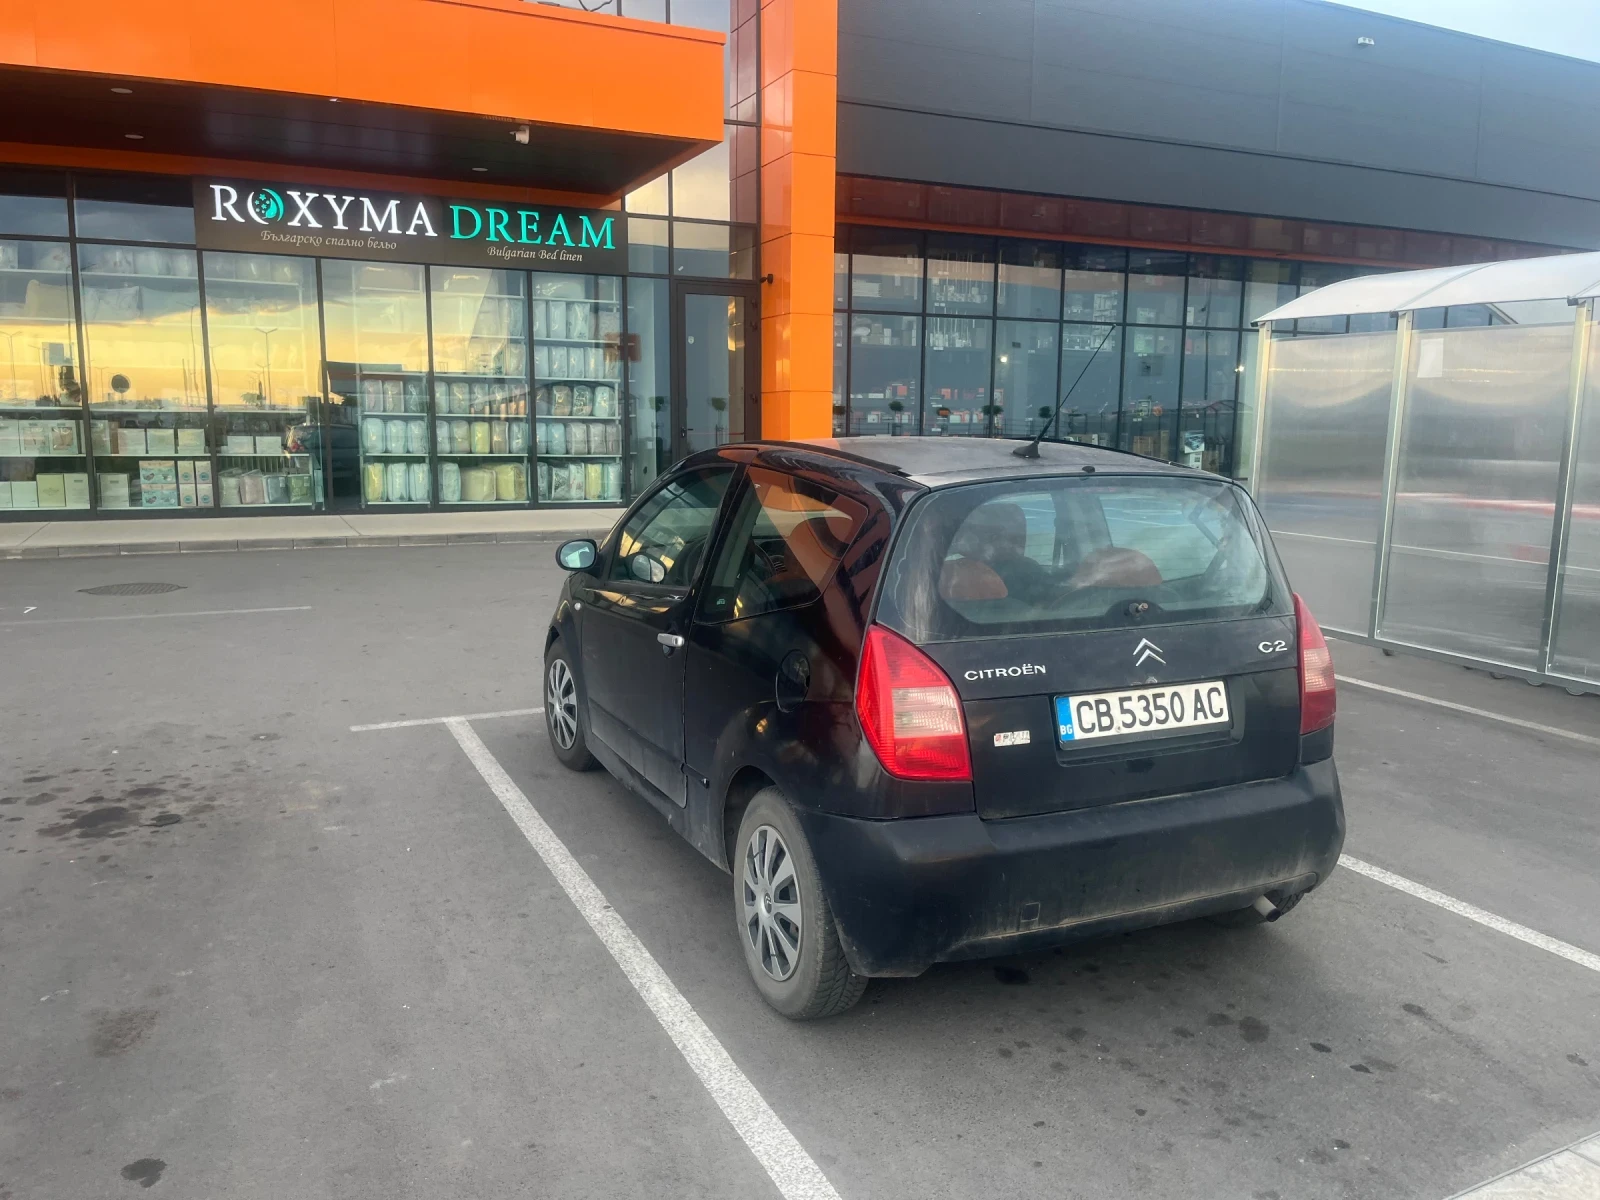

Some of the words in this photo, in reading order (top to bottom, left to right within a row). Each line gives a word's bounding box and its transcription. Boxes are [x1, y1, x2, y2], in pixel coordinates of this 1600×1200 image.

[209, 184, 438, 238] ROXYMA
[450, 204, 616, 250] DREAM
[260, 230, 323, 247] Българско
[325, 236, 364, 248] спално
[367, 236, 397, 250] бельо
[486, 245, 536, 261] Bulgarian
[538, 249, 559, 260] Bed
[559, 249, 583, 262] linen
[1258, 639, 1288, 654] C2
[964, 663, 1046, 681] CITROËN
[1076, 698, 1115, 734] CB
[1118, 691, 1185, 729] 5350
[1193, 686, 1224, 721] AC
[1059, 725, 1073, 735] BG
